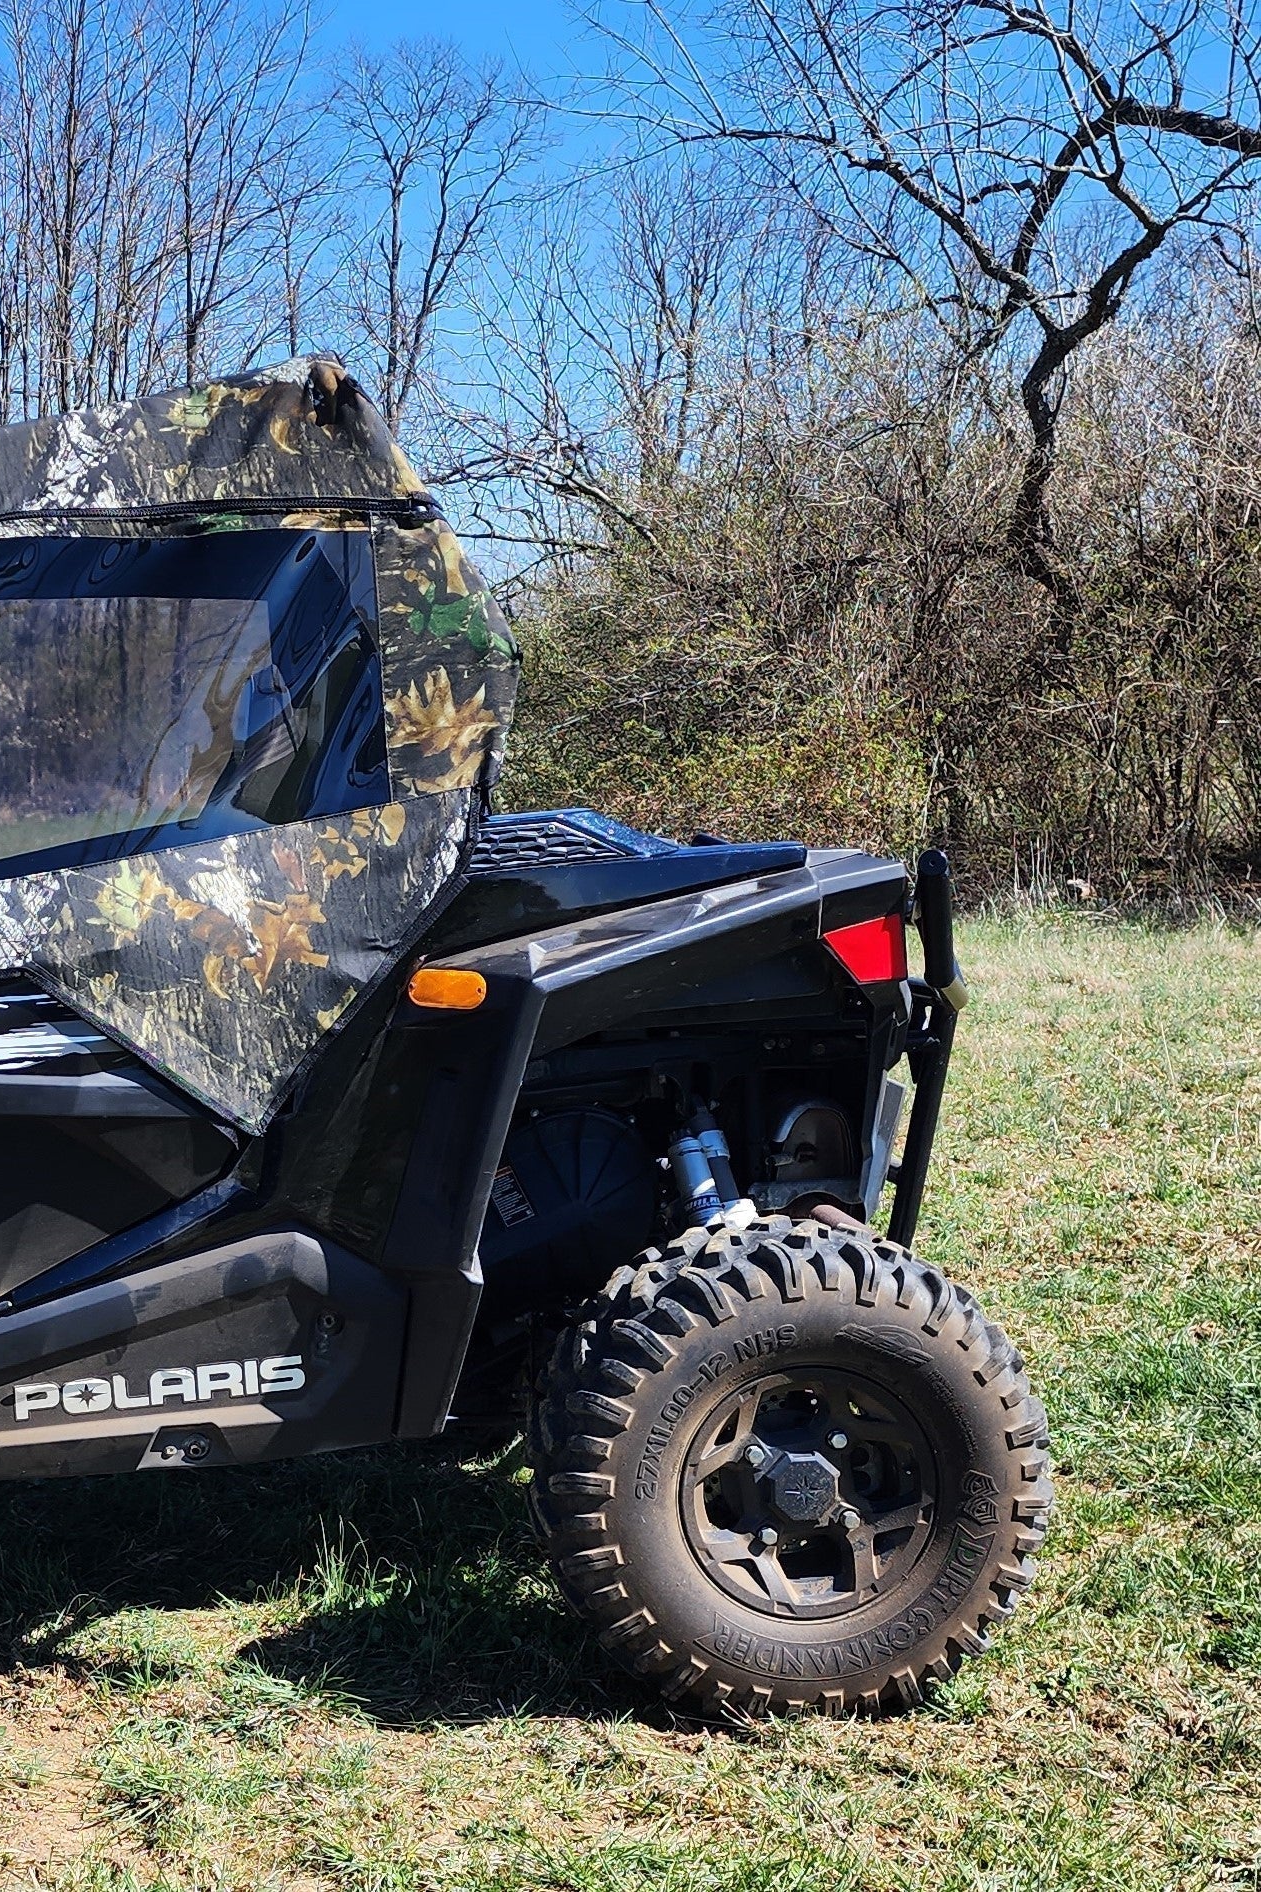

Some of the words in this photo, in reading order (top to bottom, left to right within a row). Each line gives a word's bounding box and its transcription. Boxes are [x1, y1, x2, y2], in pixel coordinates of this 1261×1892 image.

[13, 1354, 307, 1421] POLARIS
[634, 1351, 734, 1501] 27X11.00-12
[733, 1324, 798, 1364] NHS
[929, 1537, 988, 1614] DIRT
[714, 1607, 936, 1678] COMMANDER
